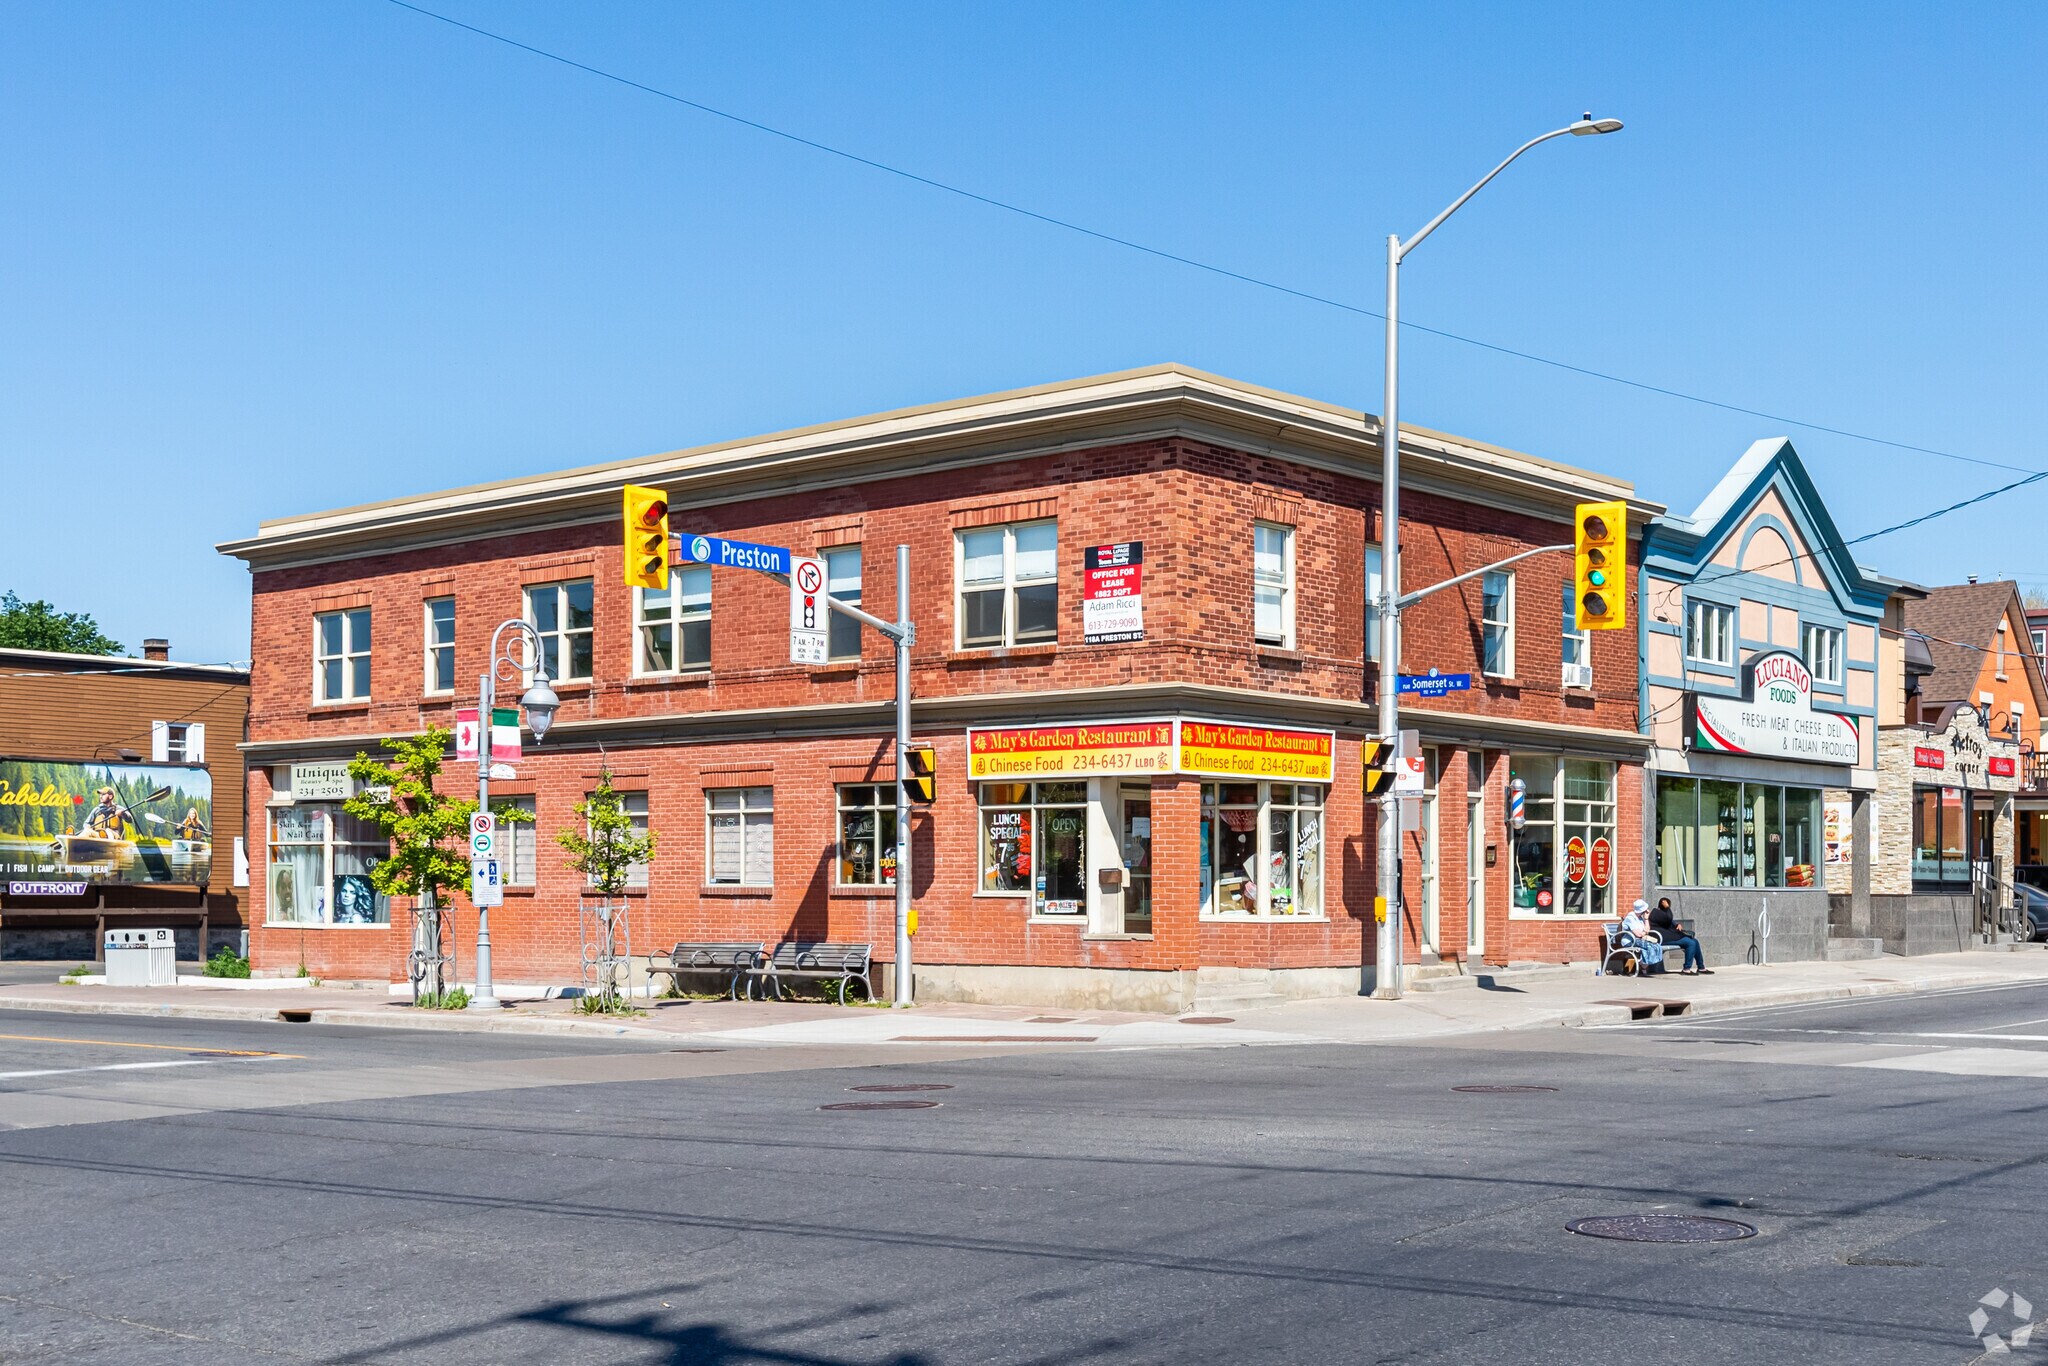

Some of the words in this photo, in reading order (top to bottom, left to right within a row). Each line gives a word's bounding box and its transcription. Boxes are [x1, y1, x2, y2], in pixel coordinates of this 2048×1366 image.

[721, 541, 780, 571] Preston
[1092, 570, 1118, 579] OFFICE
[1119, 567, 1134, 576] FOR
[1101, 578, 1125, 588] LEASE
[1112, 588, 1132, 596] SQFT
[1089, 601, 1114, 611] Adam
[1116, 599, 1136, 609] Ricci
[1088, 617, 1138, 631] 613-729-9090
[793, 636, 798, 645] 7
[812, 637, 816, 646] 7
[1101, 633, 1132, 642] PRESTON
[1755, 658, 1809, 693] LUCIANO
[1412, 678, 1447, 690] Somerset
[1770, 687, 1796, 704] FOODS
[1698, 698, 1736, 742] SPECIALIZING
[1738, 735, 1746, 747] IN
[1741, 712, 1767, 728] FRESH
[1827, 723, 1842, 738] DELI
[989, 730, 1027, 752] May's
[1029, 729, 1074, 748] Garden
[1077, 726, 1152, 747] Restaurant
[1156, 726, 1169, 744] 酒
[1195, 725, 1226, 748] May's
[1227, 728, 1263, 749] Garden
[1265, 730, 1318, 753] Restaurant
[1782, 736, 1788, 750] &
[1792, 738, 1818, 753] ITALIAN
[1821, 741, 1856, 758] PRODUCTS
[990, 757, 1032, 773] Chinese
[1035, 756, 1063, 771] Food
[1073, 753, 1132, 770] 234-6437
[1135, 757, 1155, 768] LLBO
[1157, 751, 1169, 769] 家
[1194, 751, 1229, 769] Chinese
[1232, 755, 1254, 770] Food
[1260, 757, 1304, 774] 234-6437
[1305, 764, 1319, 775] LLBO
[296, 767, 347, 781] Unique
[299, 787, 344, 796] 234-2505
[993, 813, 1021, 825] LUNCH
[1052, 818, 1077, 831] OPEN
[286, 831, 303, 839] Nail
[305, 831, 324, 839] Care
[990, 826, 1023, 840] SPECIAL
[1298, 818, 1319, 842] LUNCH
[1297, 832, 1320, 858] SPECIAL
[1769, 833, 1781, 843] OPEN
[13, 864, 28, 873] FISH
[37, 864, 55, 873] CAMP
[65, 865, 92, 874] OUTDOOR
[92, 865, 109, 874] GEAR
[12, 883, 83, 894] OUTFRONT
